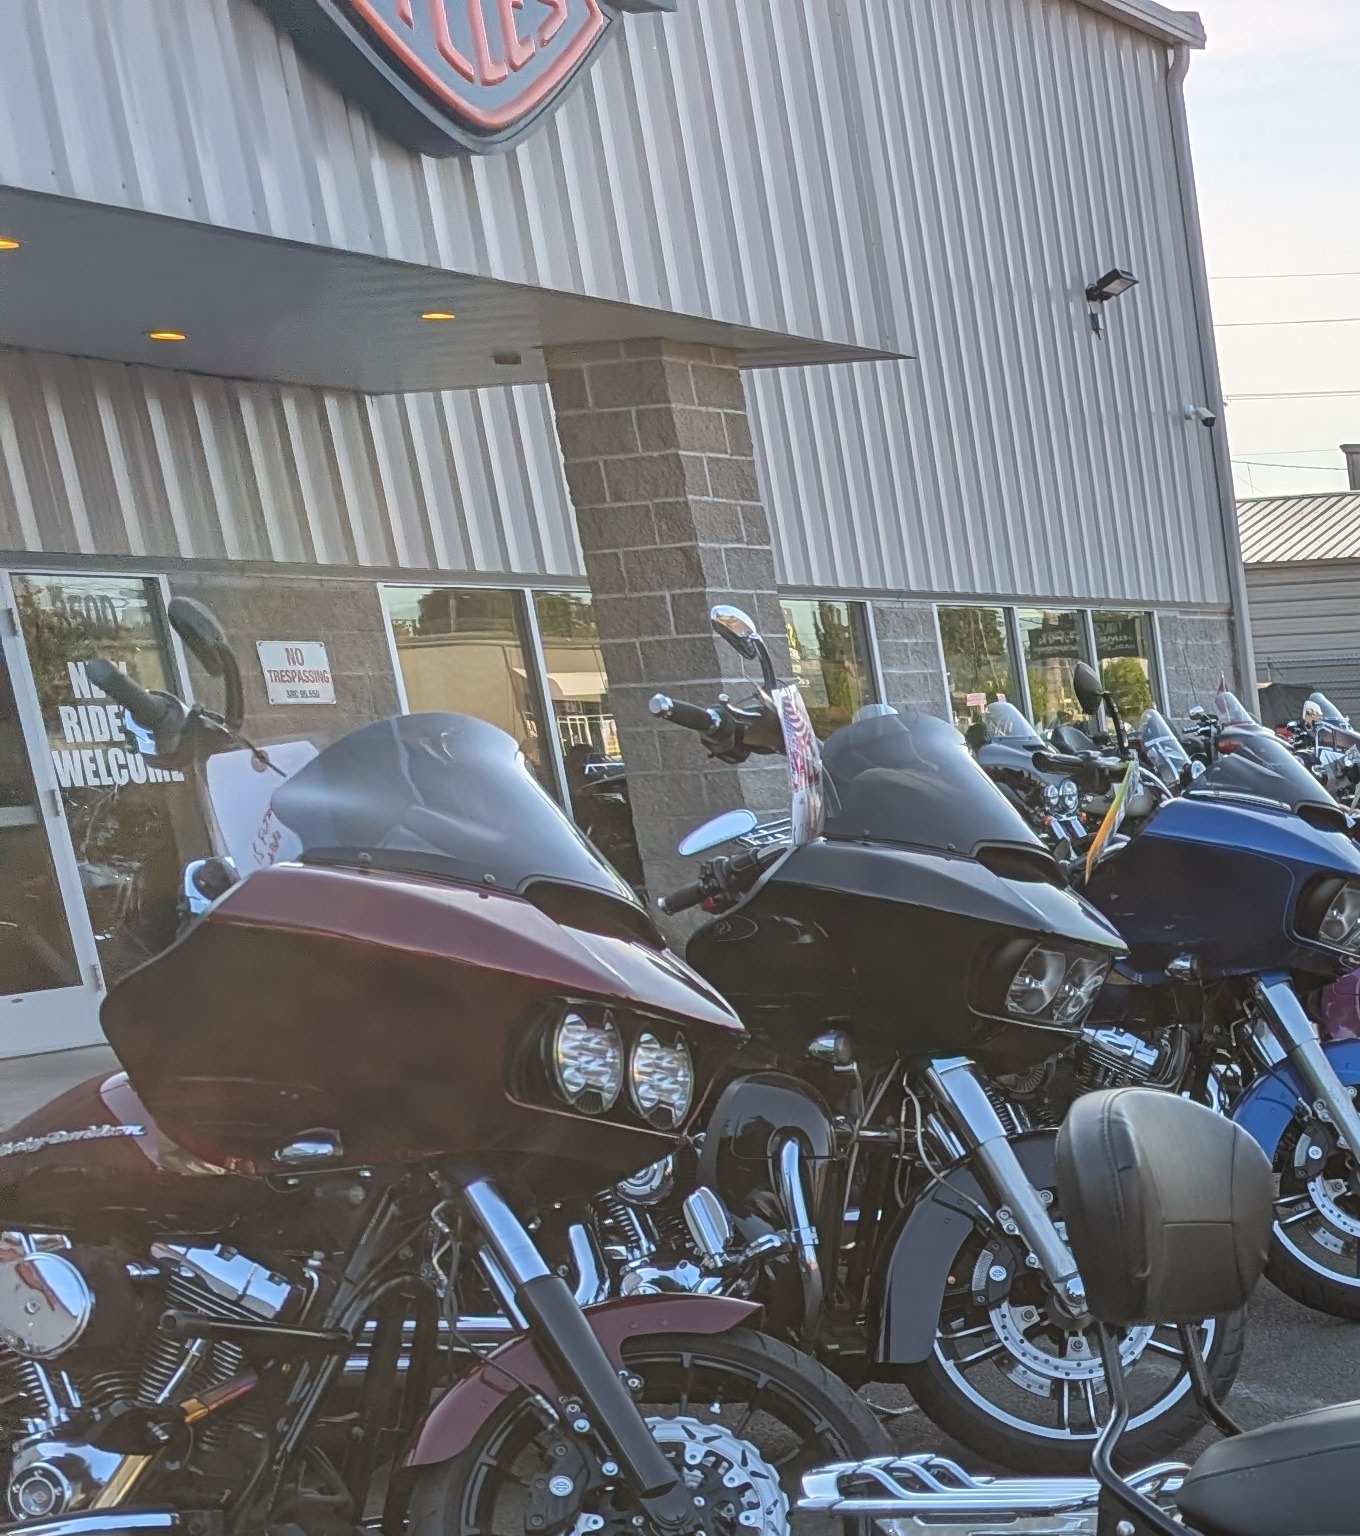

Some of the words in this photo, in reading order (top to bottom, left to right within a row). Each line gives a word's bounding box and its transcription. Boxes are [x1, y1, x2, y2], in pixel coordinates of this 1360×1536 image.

[285, 648, 304, 666] NO
[267, 670, 330, 683] TRESPASSING
[59, 705, 126, 743] RIDE
